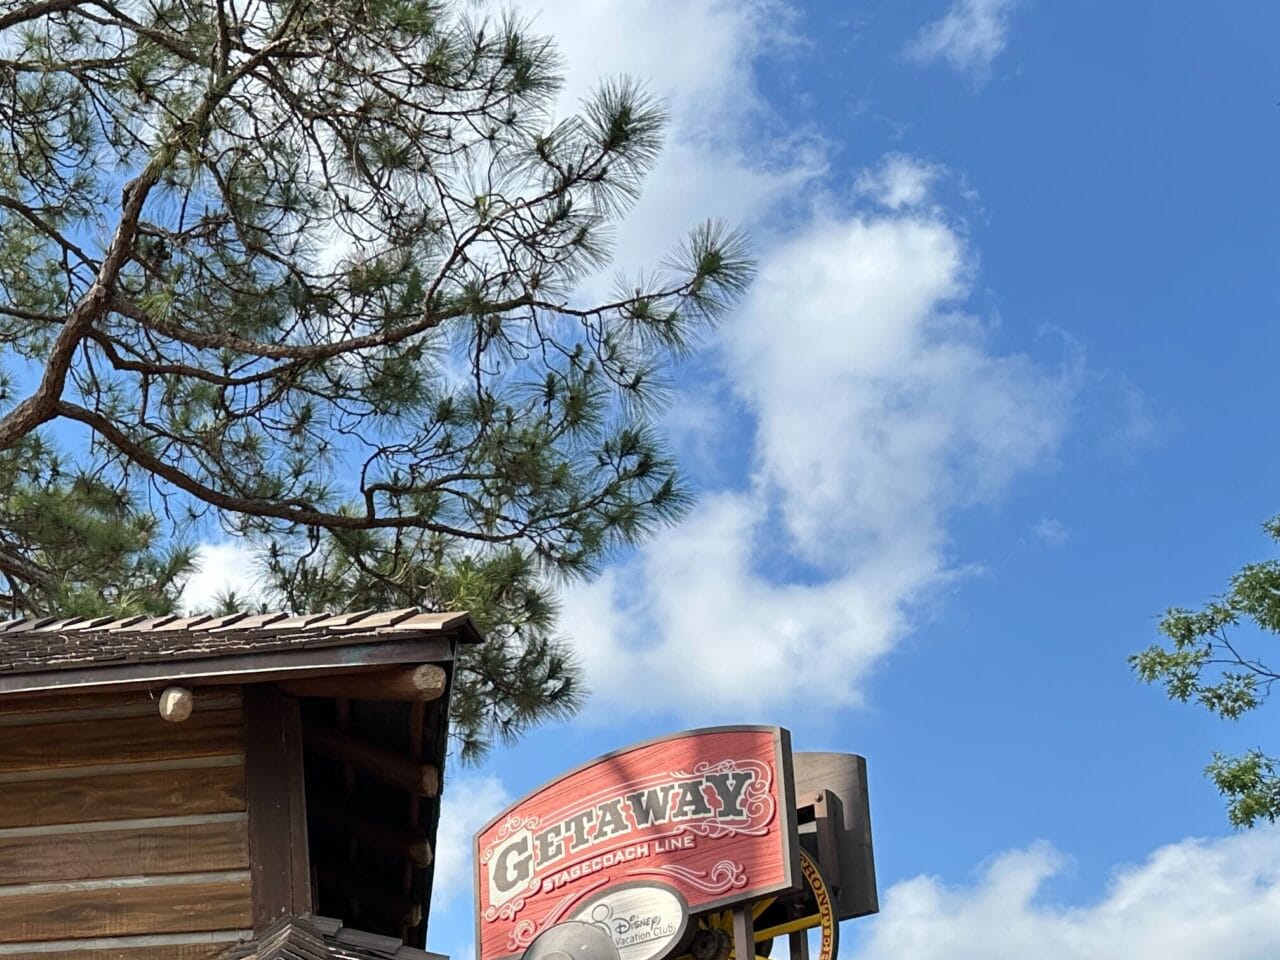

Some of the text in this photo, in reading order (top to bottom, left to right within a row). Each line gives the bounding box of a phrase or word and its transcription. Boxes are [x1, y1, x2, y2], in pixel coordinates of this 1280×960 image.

[490, 770, 753, 893] GETAWAY
[542, 834, 697, 894] STAGECOACH LINE
[615, 924, 674, 946] Vacation Club
